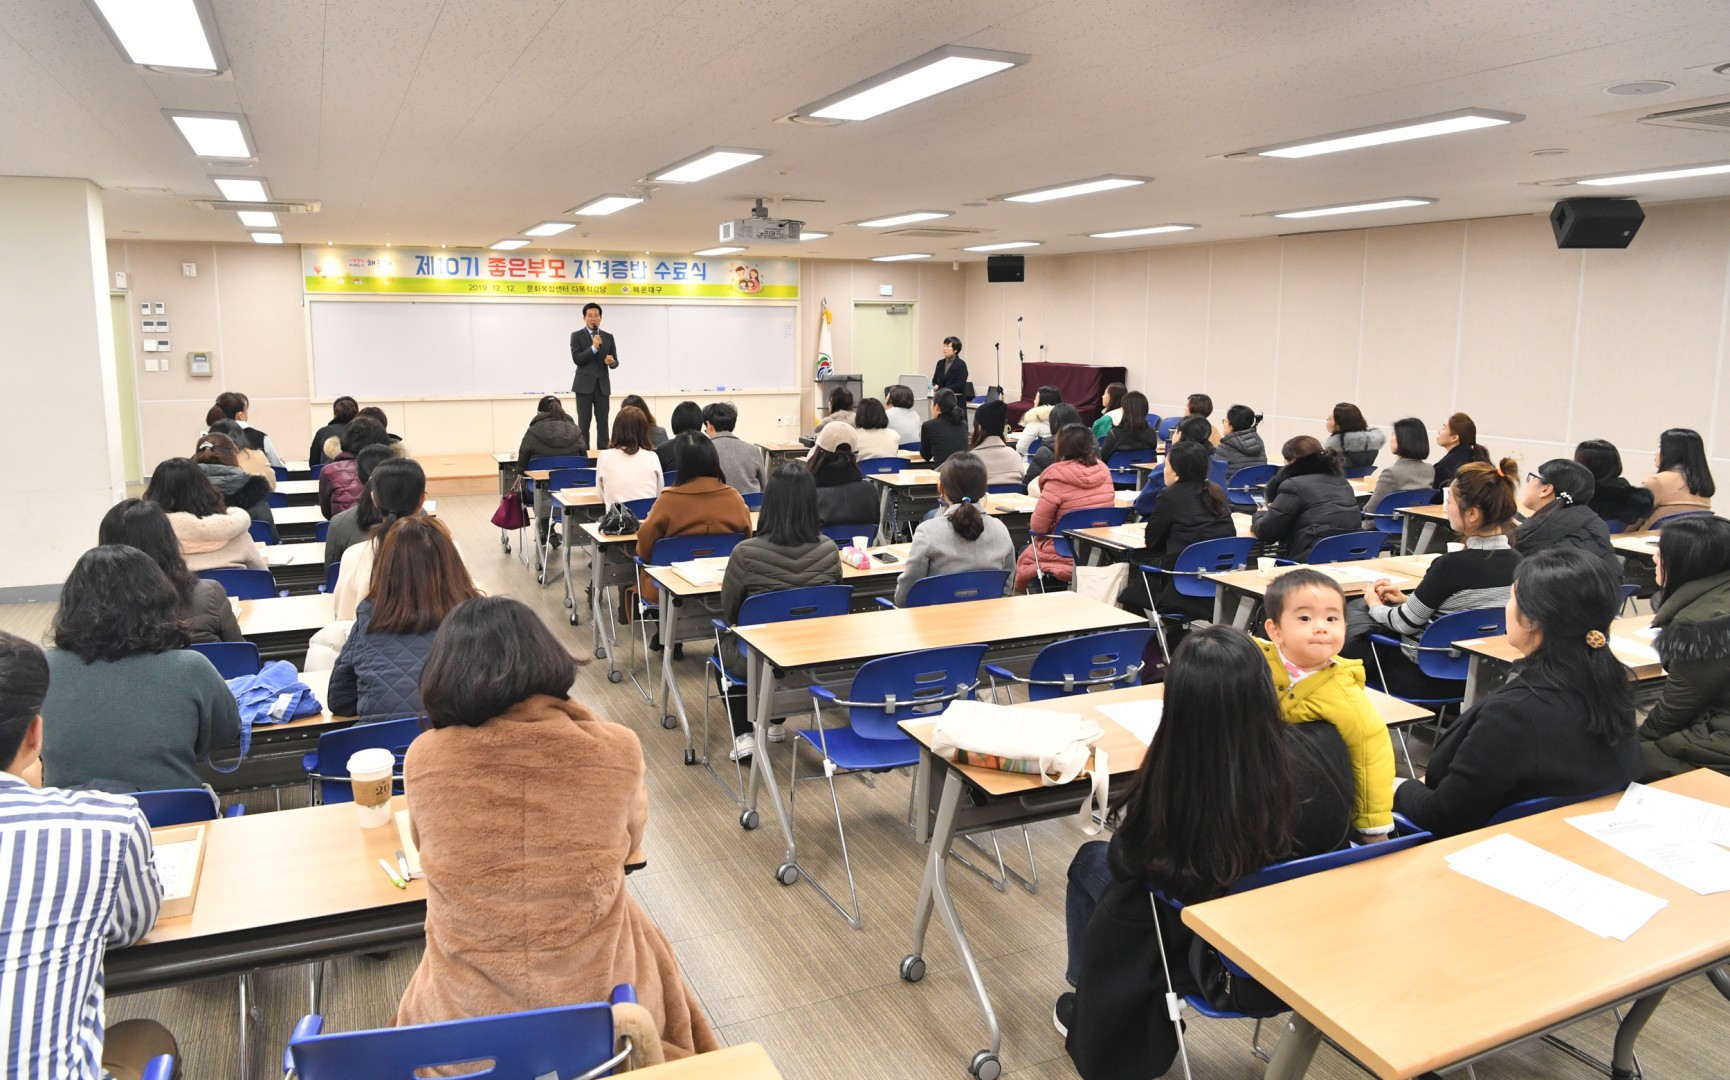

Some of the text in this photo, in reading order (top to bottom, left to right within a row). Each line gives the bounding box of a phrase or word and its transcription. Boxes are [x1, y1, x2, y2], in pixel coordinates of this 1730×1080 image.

[415, 255, 707, 281] 제10기 좋은부모 자격증반 수료식
[527, 284, 569, 293] 문화복합센터
[571, 285, 607, 293] 다목적강당
[632, 286, 662, 294] 해운대구
